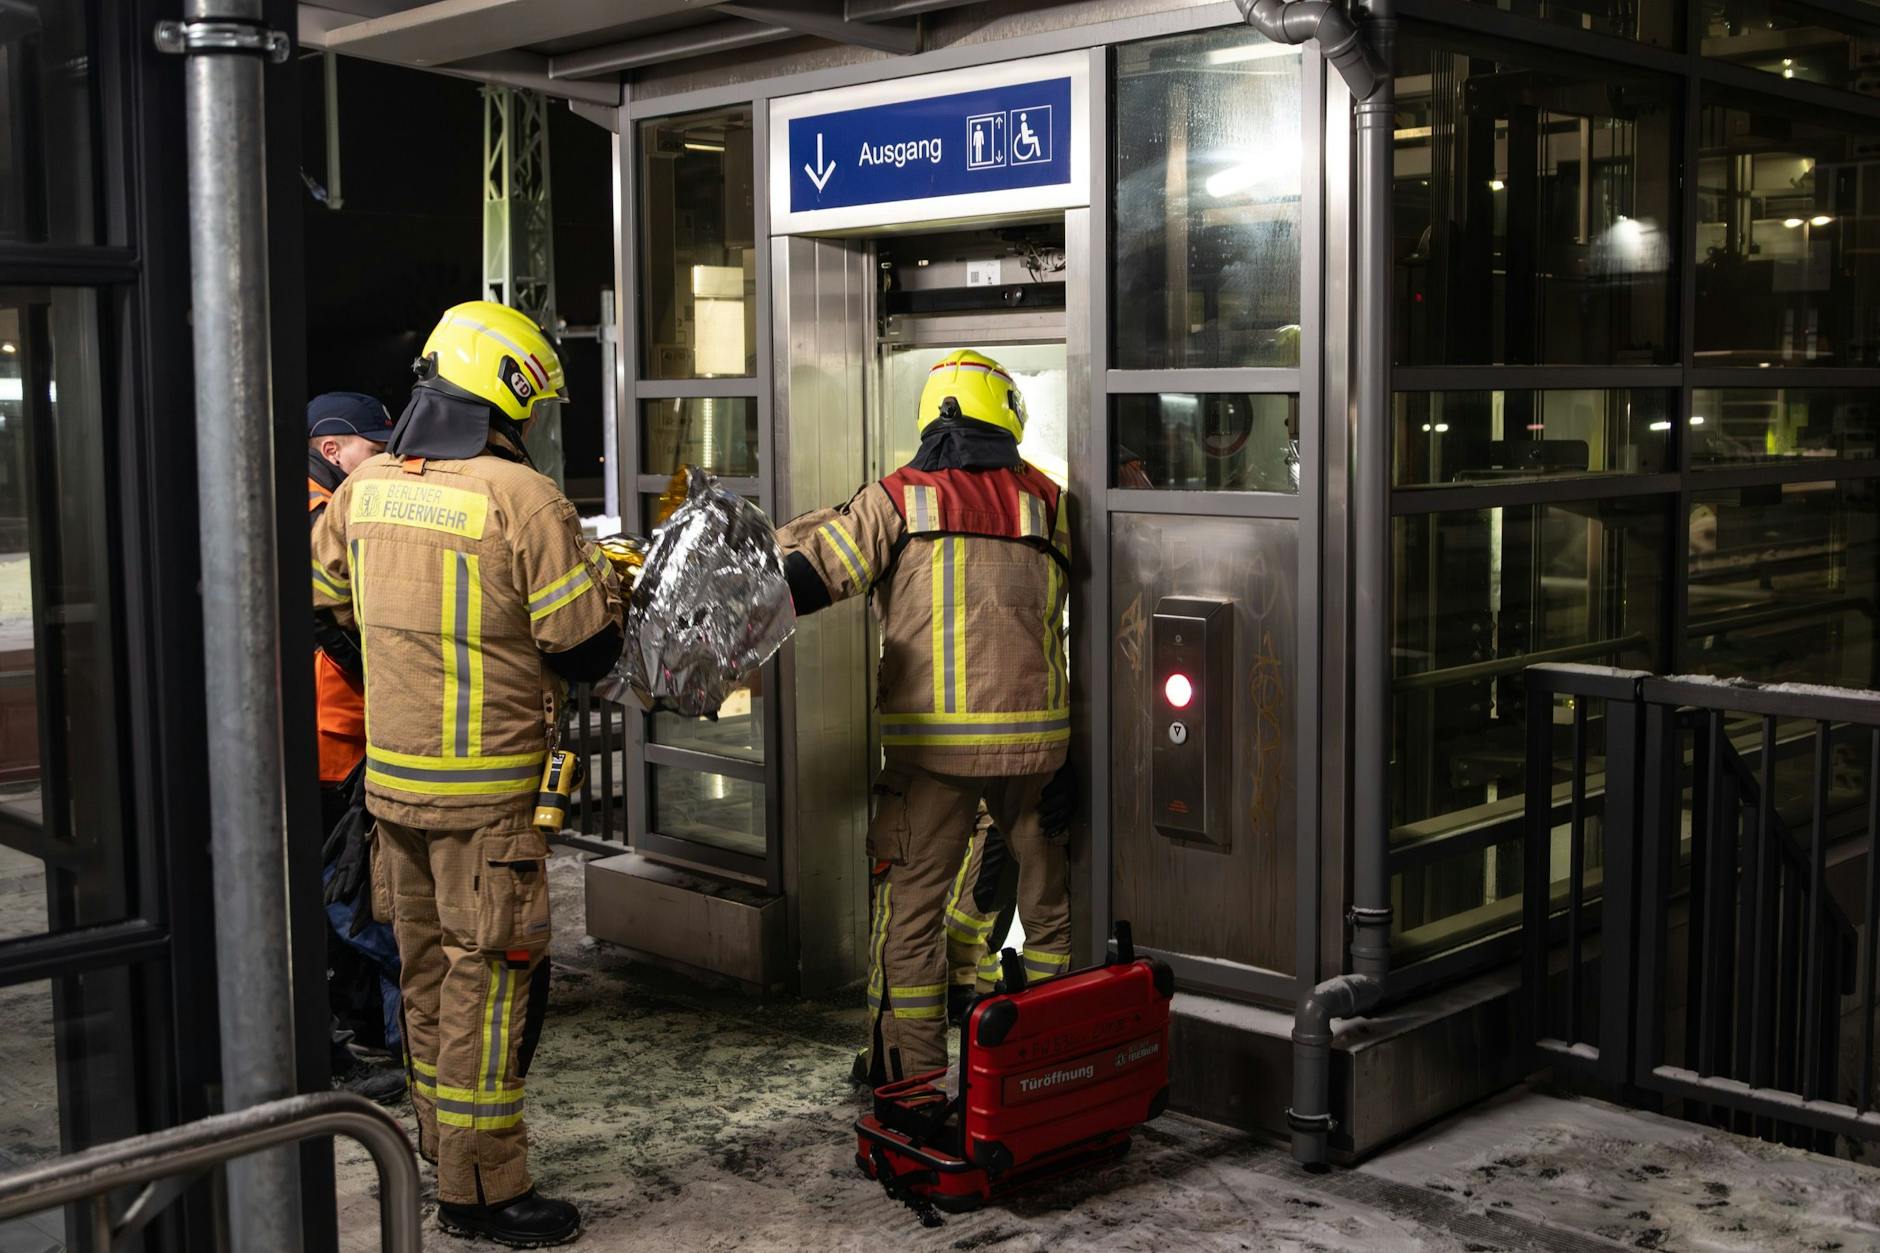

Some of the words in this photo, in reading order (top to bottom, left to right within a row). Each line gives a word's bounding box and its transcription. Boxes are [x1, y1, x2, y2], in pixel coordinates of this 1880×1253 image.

[858, 138, 942, 168] Ausgang
[514, 374, 529, 396] TD
[387, 484, 442, 503] BERLINER
[383, 500, 468, 529] FEUERWEHR
[1020, 1065, 1094, 1092] Türöffnung
